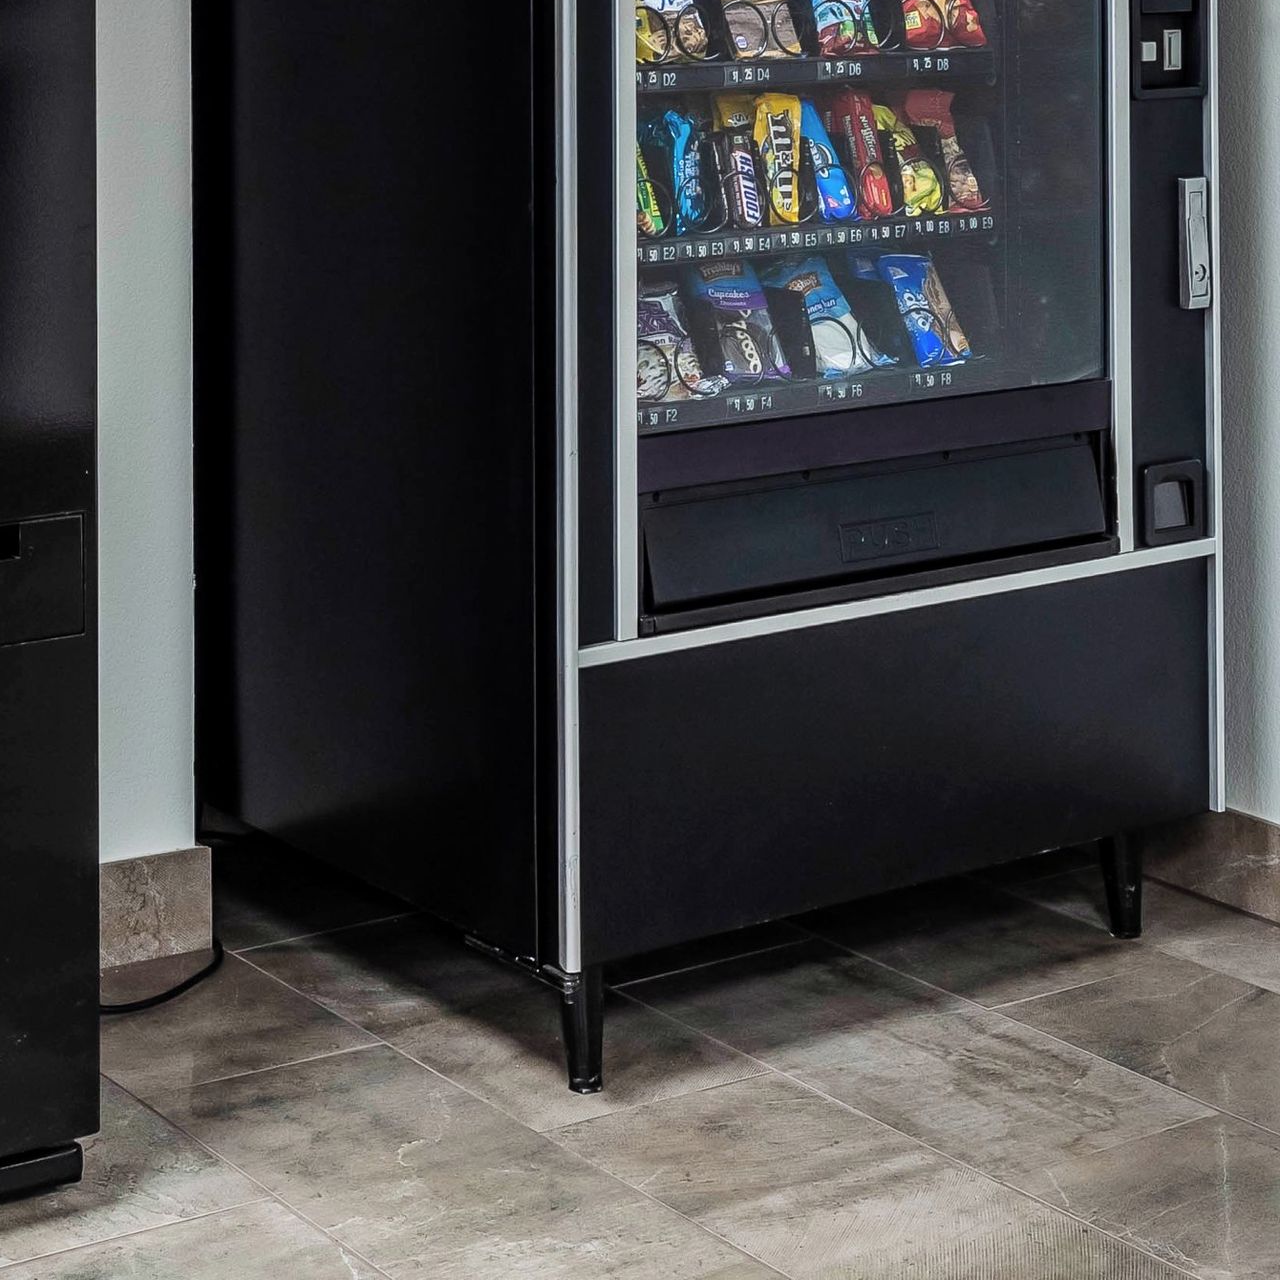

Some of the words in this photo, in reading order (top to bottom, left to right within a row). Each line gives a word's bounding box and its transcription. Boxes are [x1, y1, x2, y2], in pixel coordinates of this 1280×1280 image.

[849, 62, 861, 76] D6
[937, 58, 949, 71] D8
[663, 73, 676, 86] D2
[757, 68, 769, 81] D4
[939, 221, 950, 234] E8
[982, 216, 993, 229] E9
[850, 229, 862, 242] E6
[895, 225, 906, 238] E7
[759, 238, 770, 250] E4
[805, 233, 816, 246] E5
[663, 246, 675, 260] E2
[712, 242, 723, 255] E3
[708, 287, 751, 299] Cupcakes
[941, 372, 952, 386] F8
[851, 384, 862, 398] F6
[761, 396, 772, 410] F4
[666, 408, 678, 423] F2
